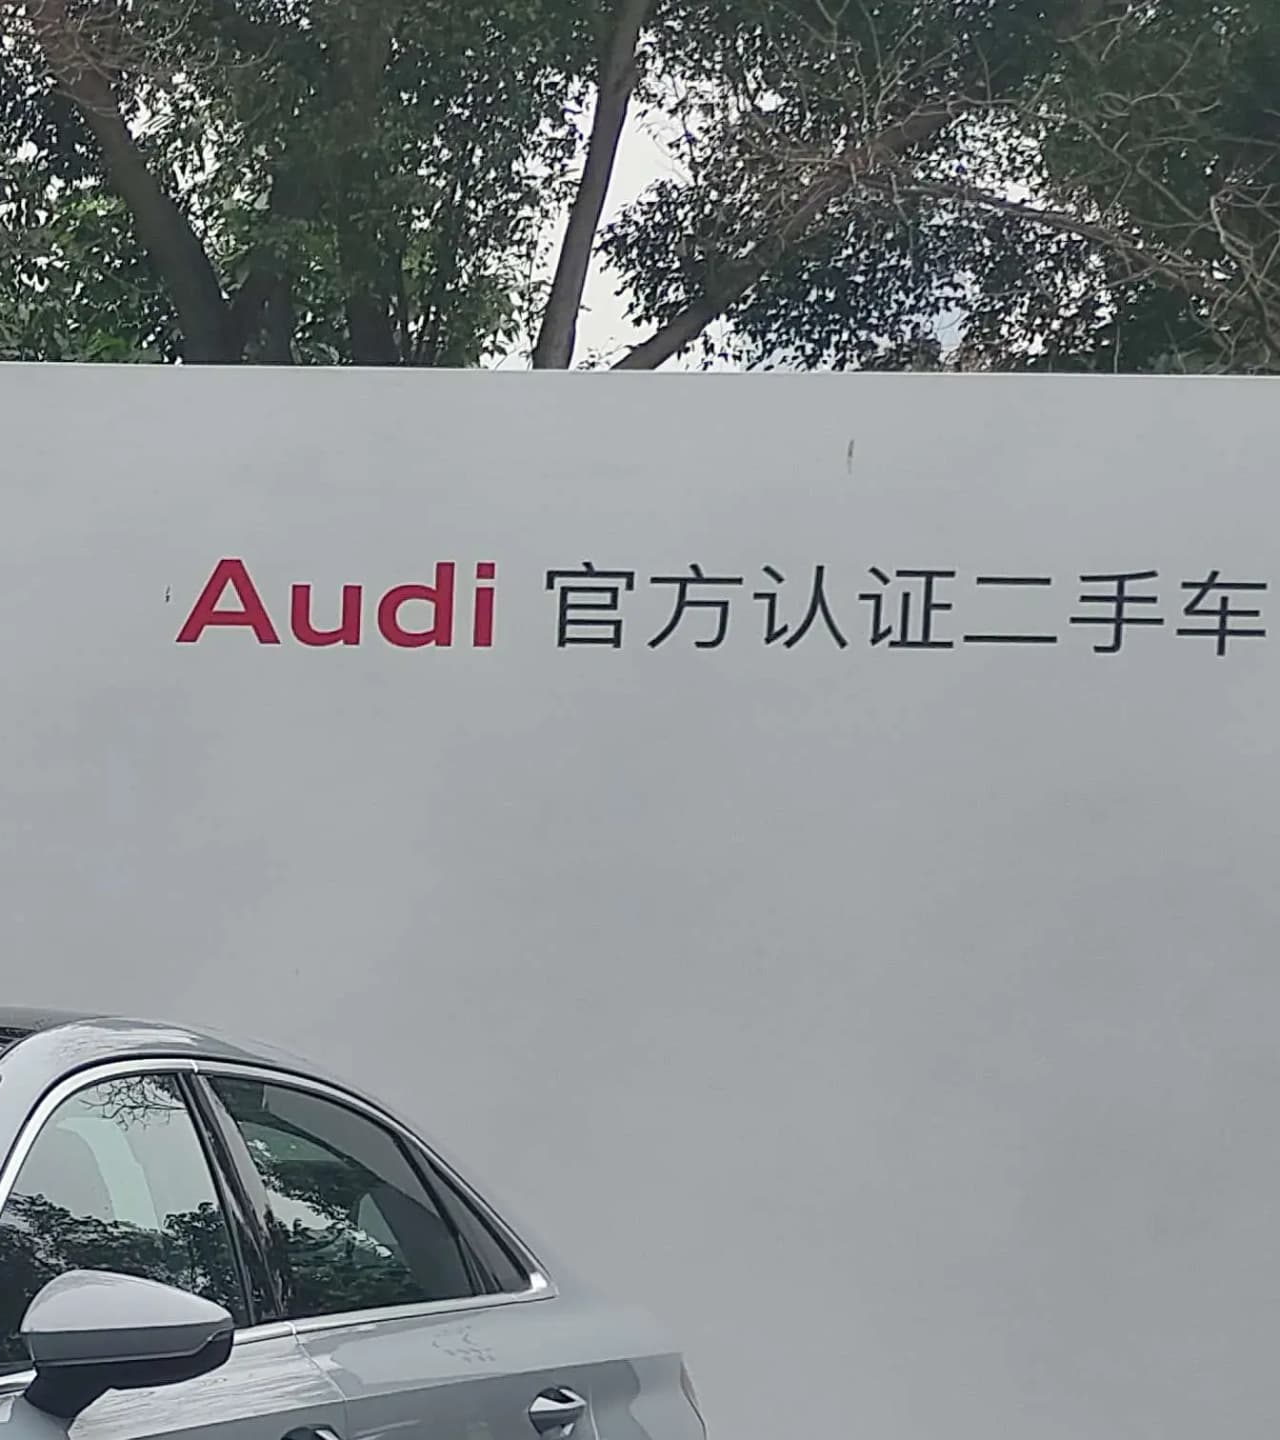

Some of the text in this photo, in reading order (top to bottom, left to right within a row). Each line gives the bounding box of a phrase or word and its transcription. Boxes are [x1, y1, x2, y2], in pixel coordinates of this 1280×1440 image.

[176, 558, 1270, 658] Audi 官方认证二手车
